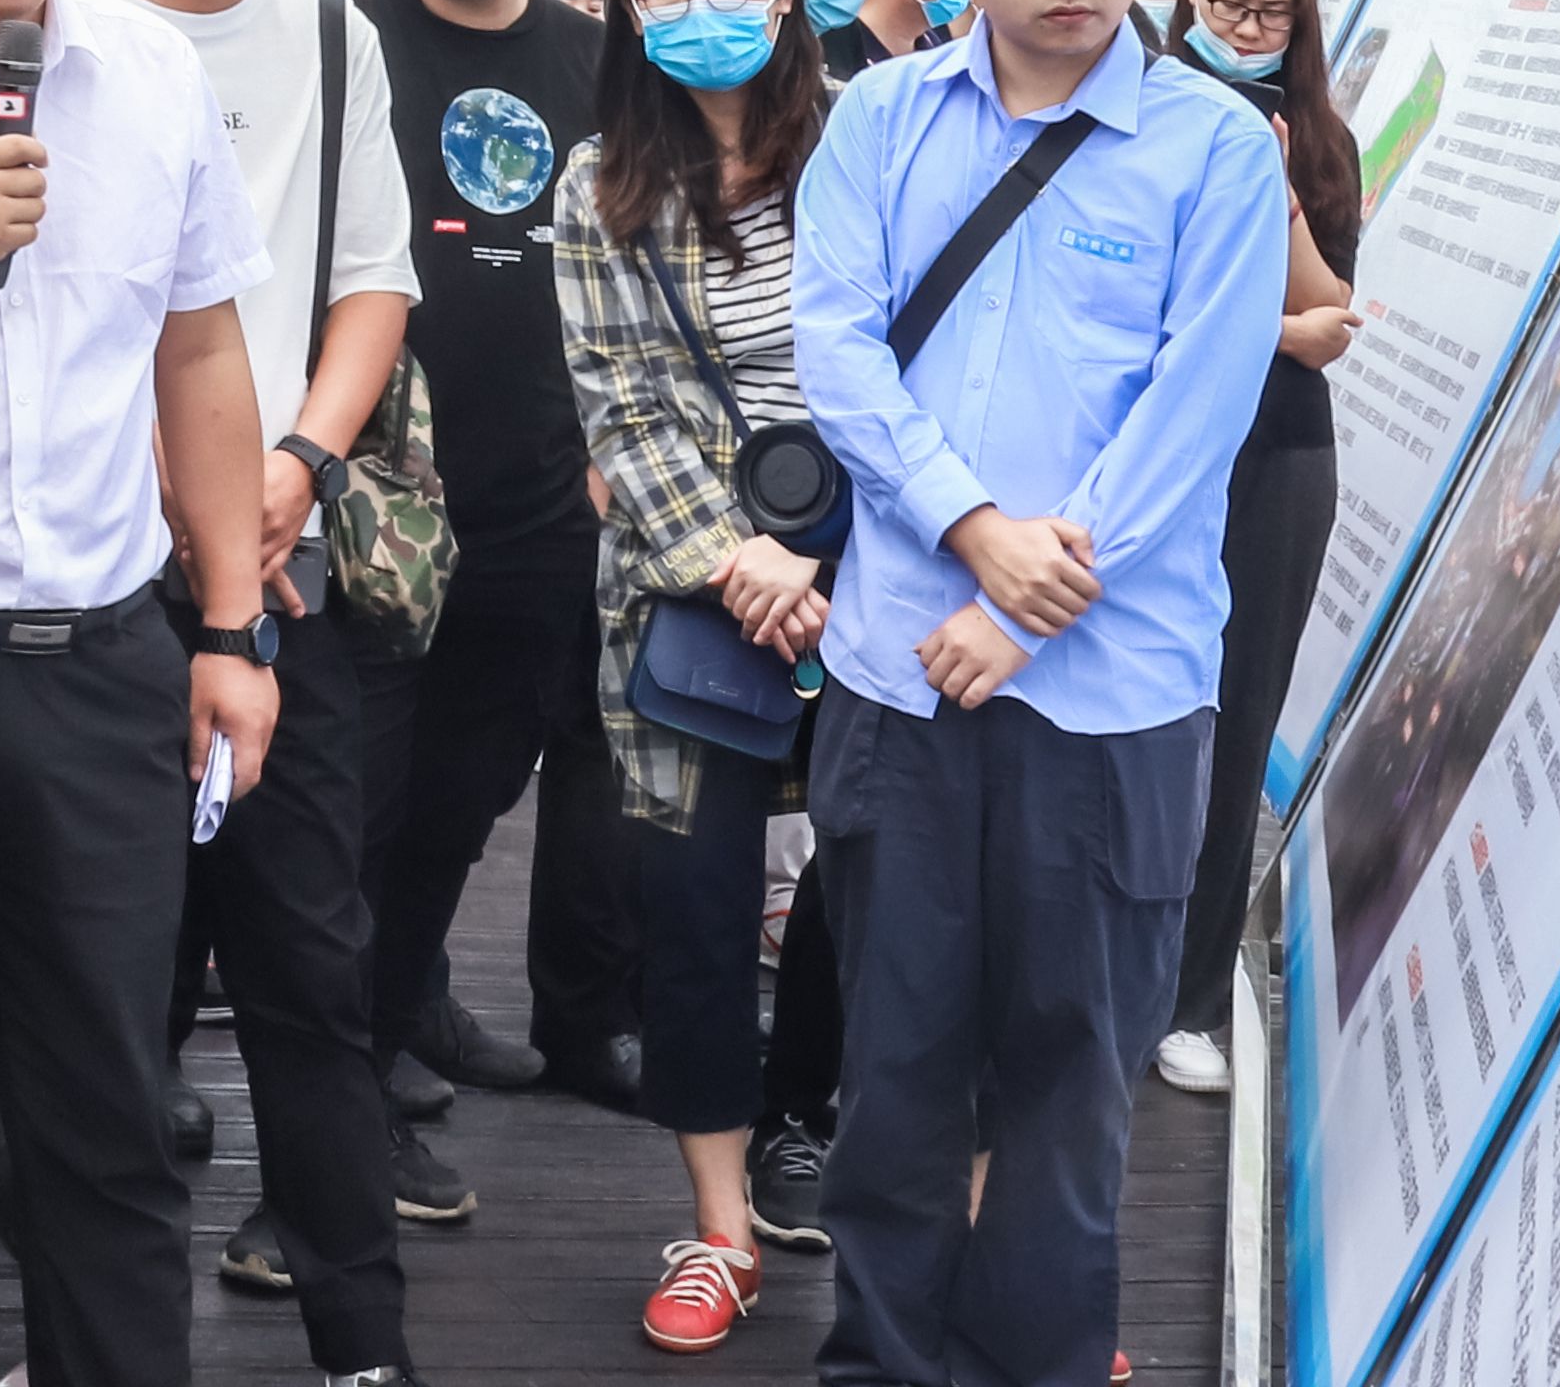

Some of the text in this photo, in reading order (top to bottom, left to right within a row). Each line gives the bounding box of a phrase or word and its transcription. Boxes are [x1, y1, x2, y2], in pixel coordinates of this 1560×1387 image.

[661, 522, 730, 569] LOVE KATE
[673, 560, 710, 587] LOVE
